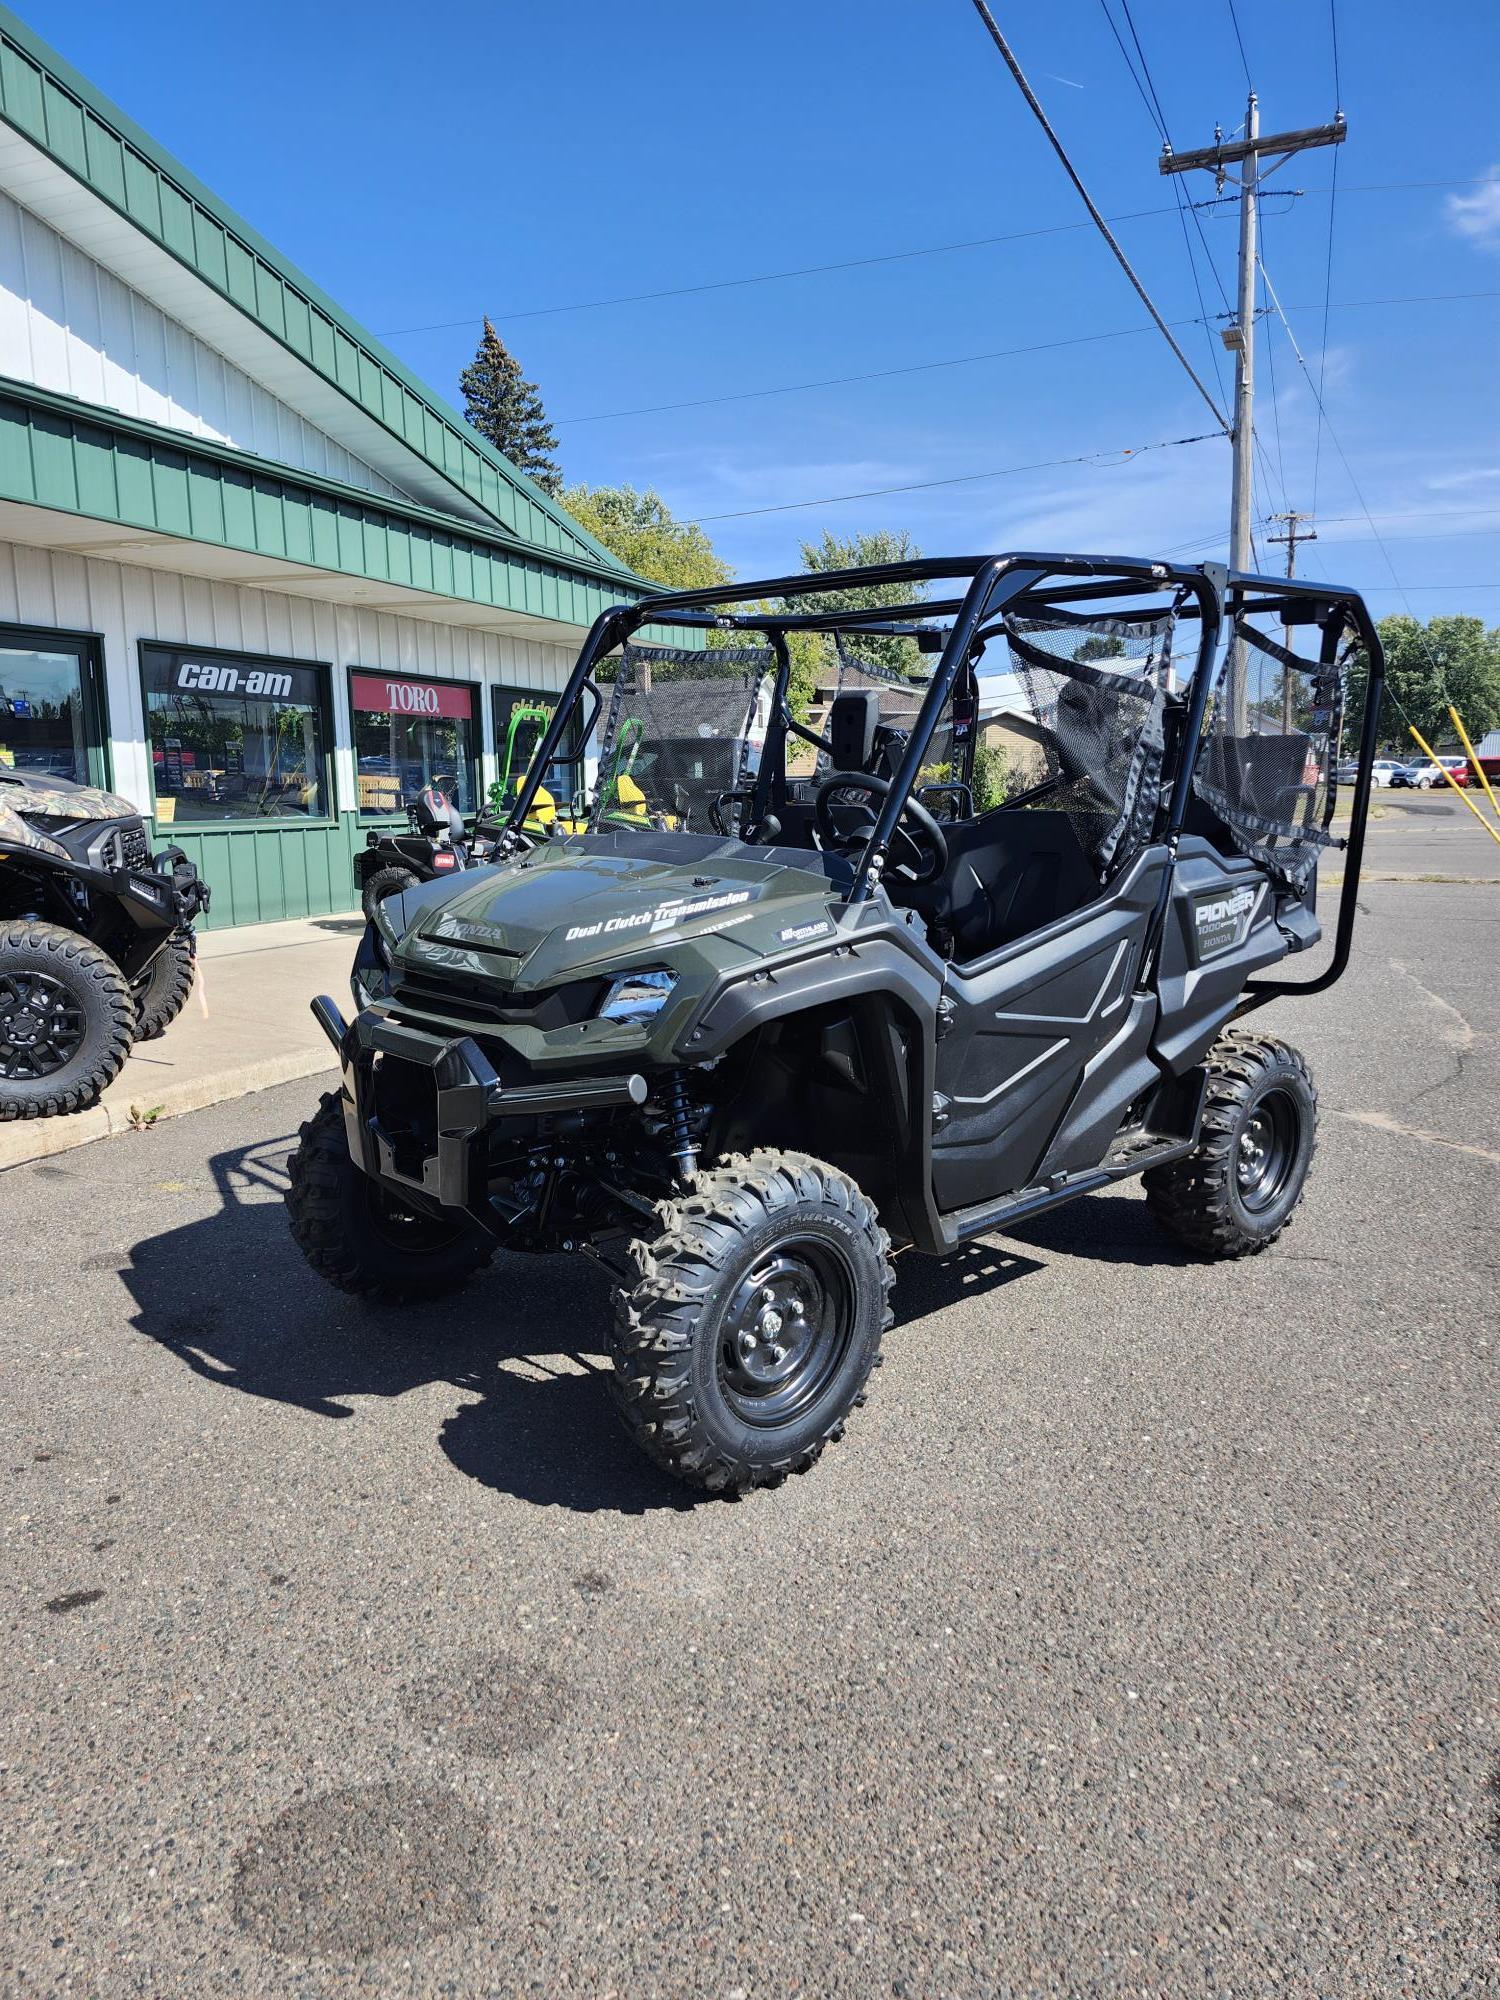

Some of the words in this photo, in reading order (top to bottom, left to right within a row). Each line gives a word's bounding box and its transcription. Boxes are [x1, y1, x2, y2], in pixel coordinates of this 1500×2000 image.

[178, 663, 292, 697] can-am
[386, 684, 438, 713] TORO
[565, 922, 603, 941] Dual
[604, 911, 652, 932] Clutch
[654, 892, 749, 920] Transmission
[1195, 890, 1255, 926] PIONEER
[1198, 922, 1221, 935] 1000
